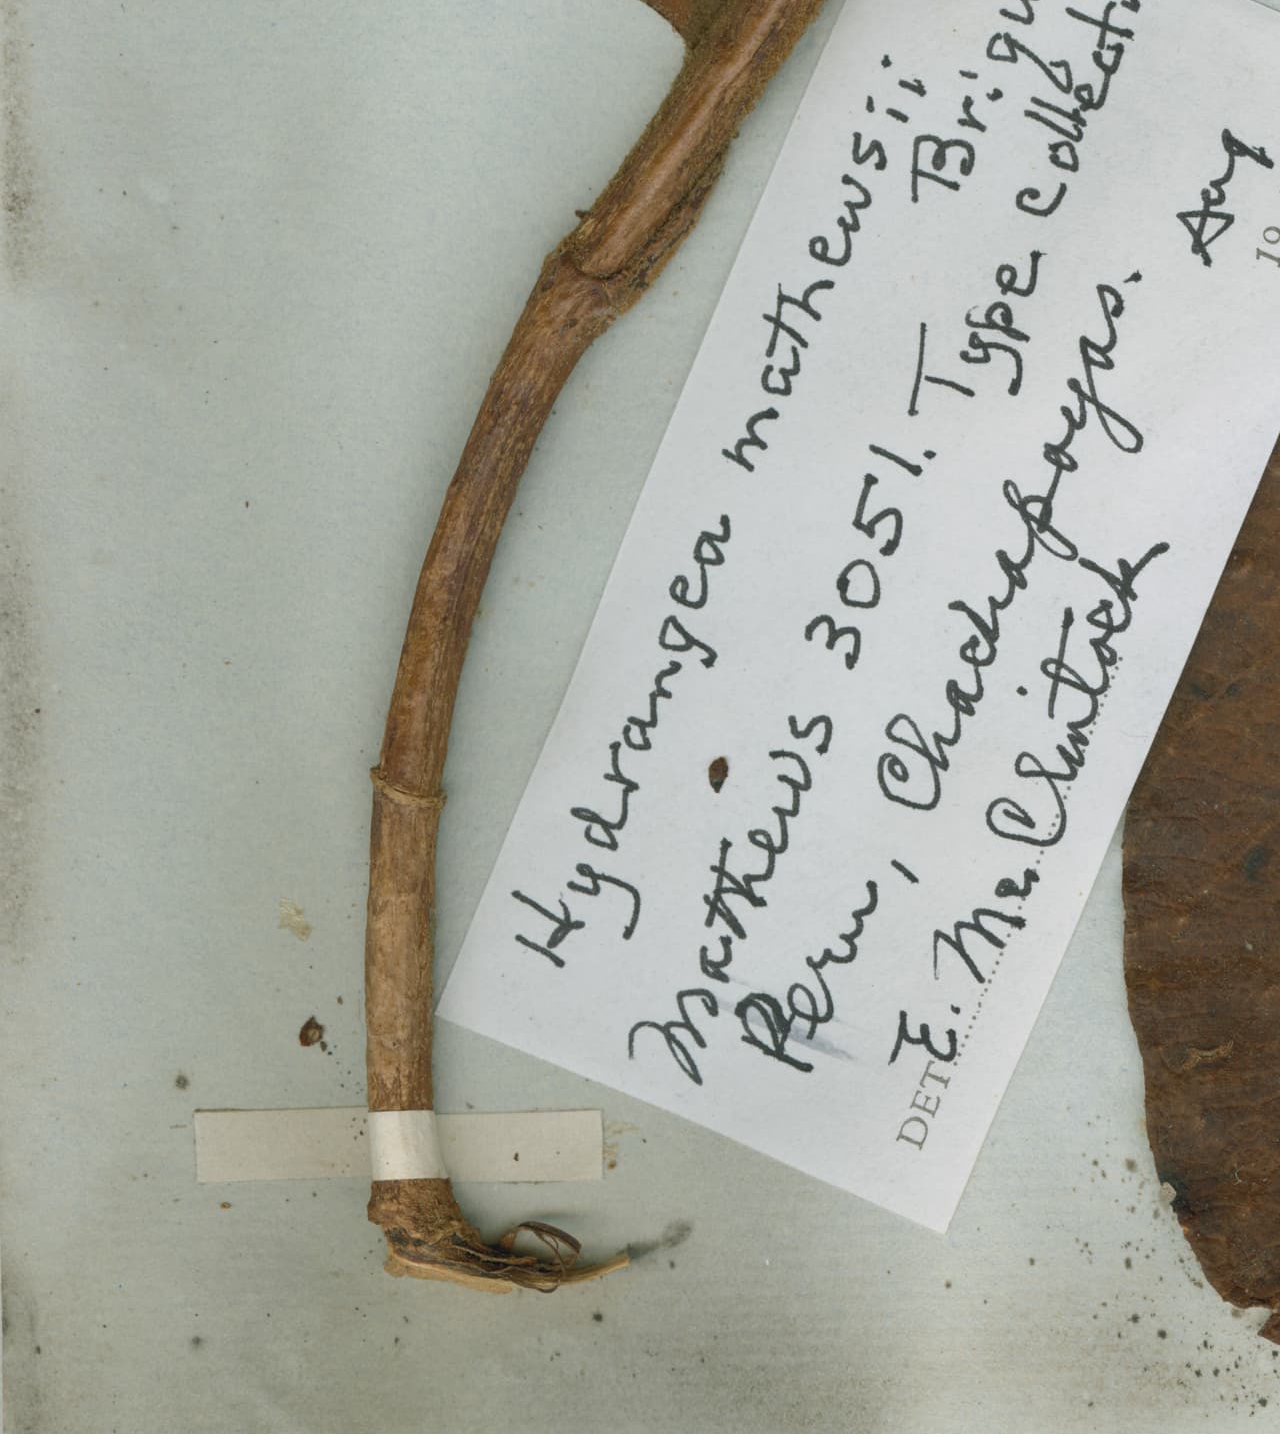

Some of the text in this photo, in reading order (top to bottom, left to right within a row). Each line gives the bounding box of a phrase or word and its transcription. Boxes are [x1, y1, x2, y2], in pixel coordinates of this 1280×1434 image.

[905, 249, 1047, 417] Type
[511, 513, 731, 967] Hydrangea
[894, 1059, 954, 1152] DET
